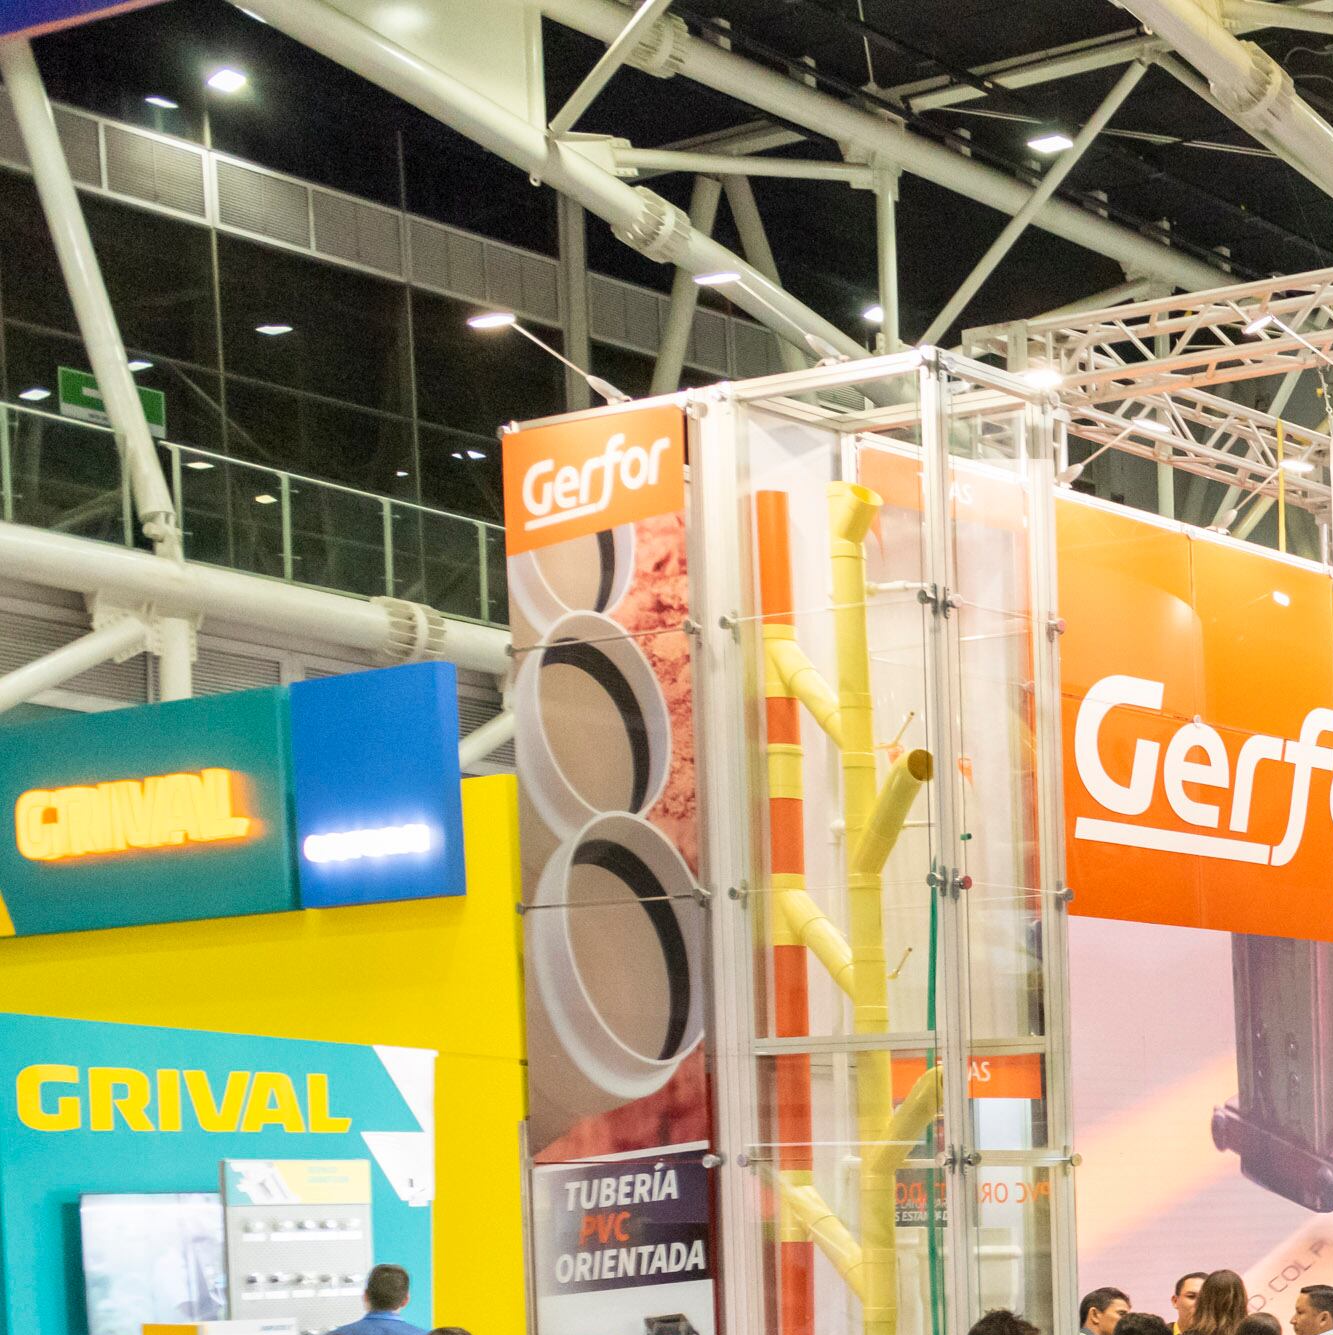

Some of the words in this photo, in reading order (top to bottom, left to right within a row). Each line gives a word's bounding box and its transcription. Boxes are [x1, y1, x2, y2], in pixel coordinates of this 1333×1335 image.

[522, 433, 671, 531] Gerfor
[15, 1064, 353, 1134] GRIVAL
[564, 1158, 679, 1213] TUBERÍA
[577, 1210, 631, 1247] PVC
[554, 1239, 706, 1284] ORIENTADA
